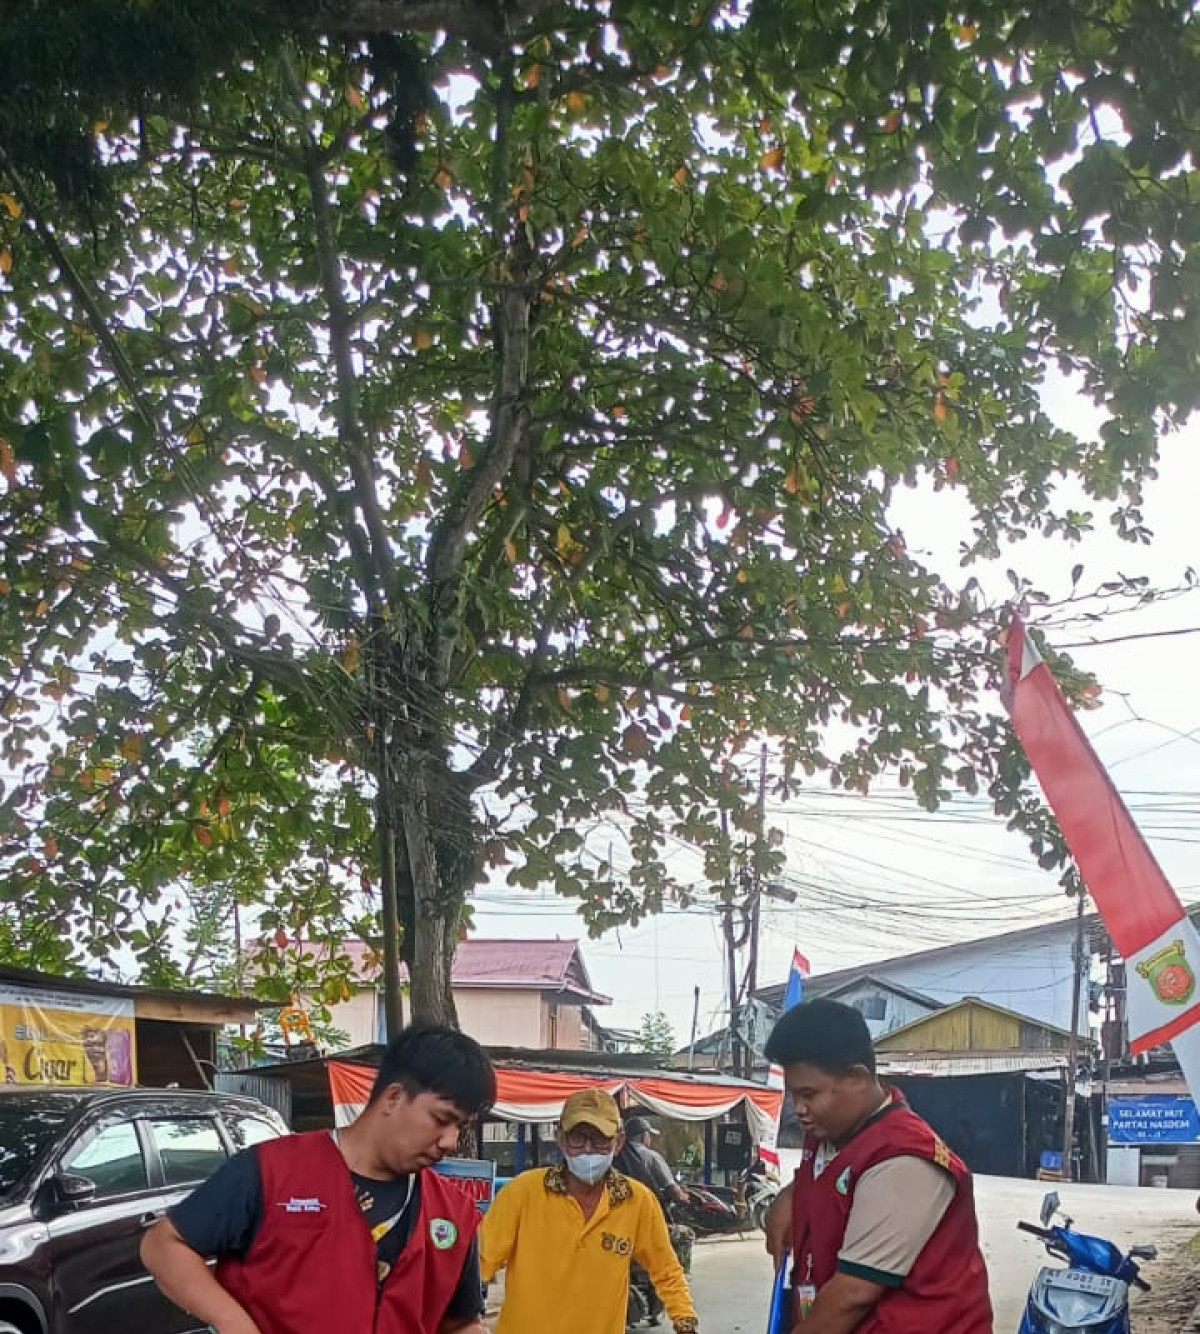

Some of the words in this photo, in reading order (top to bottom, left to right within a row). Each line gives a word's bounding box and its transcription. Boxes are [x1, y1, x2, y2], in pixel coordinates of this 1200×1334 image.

[1119, 1109, 1163, 1118] SELAMAT
[1164, 1109, 1184, 1118] HUT
[1112, 1121, 1148, 1129] PARTAI
